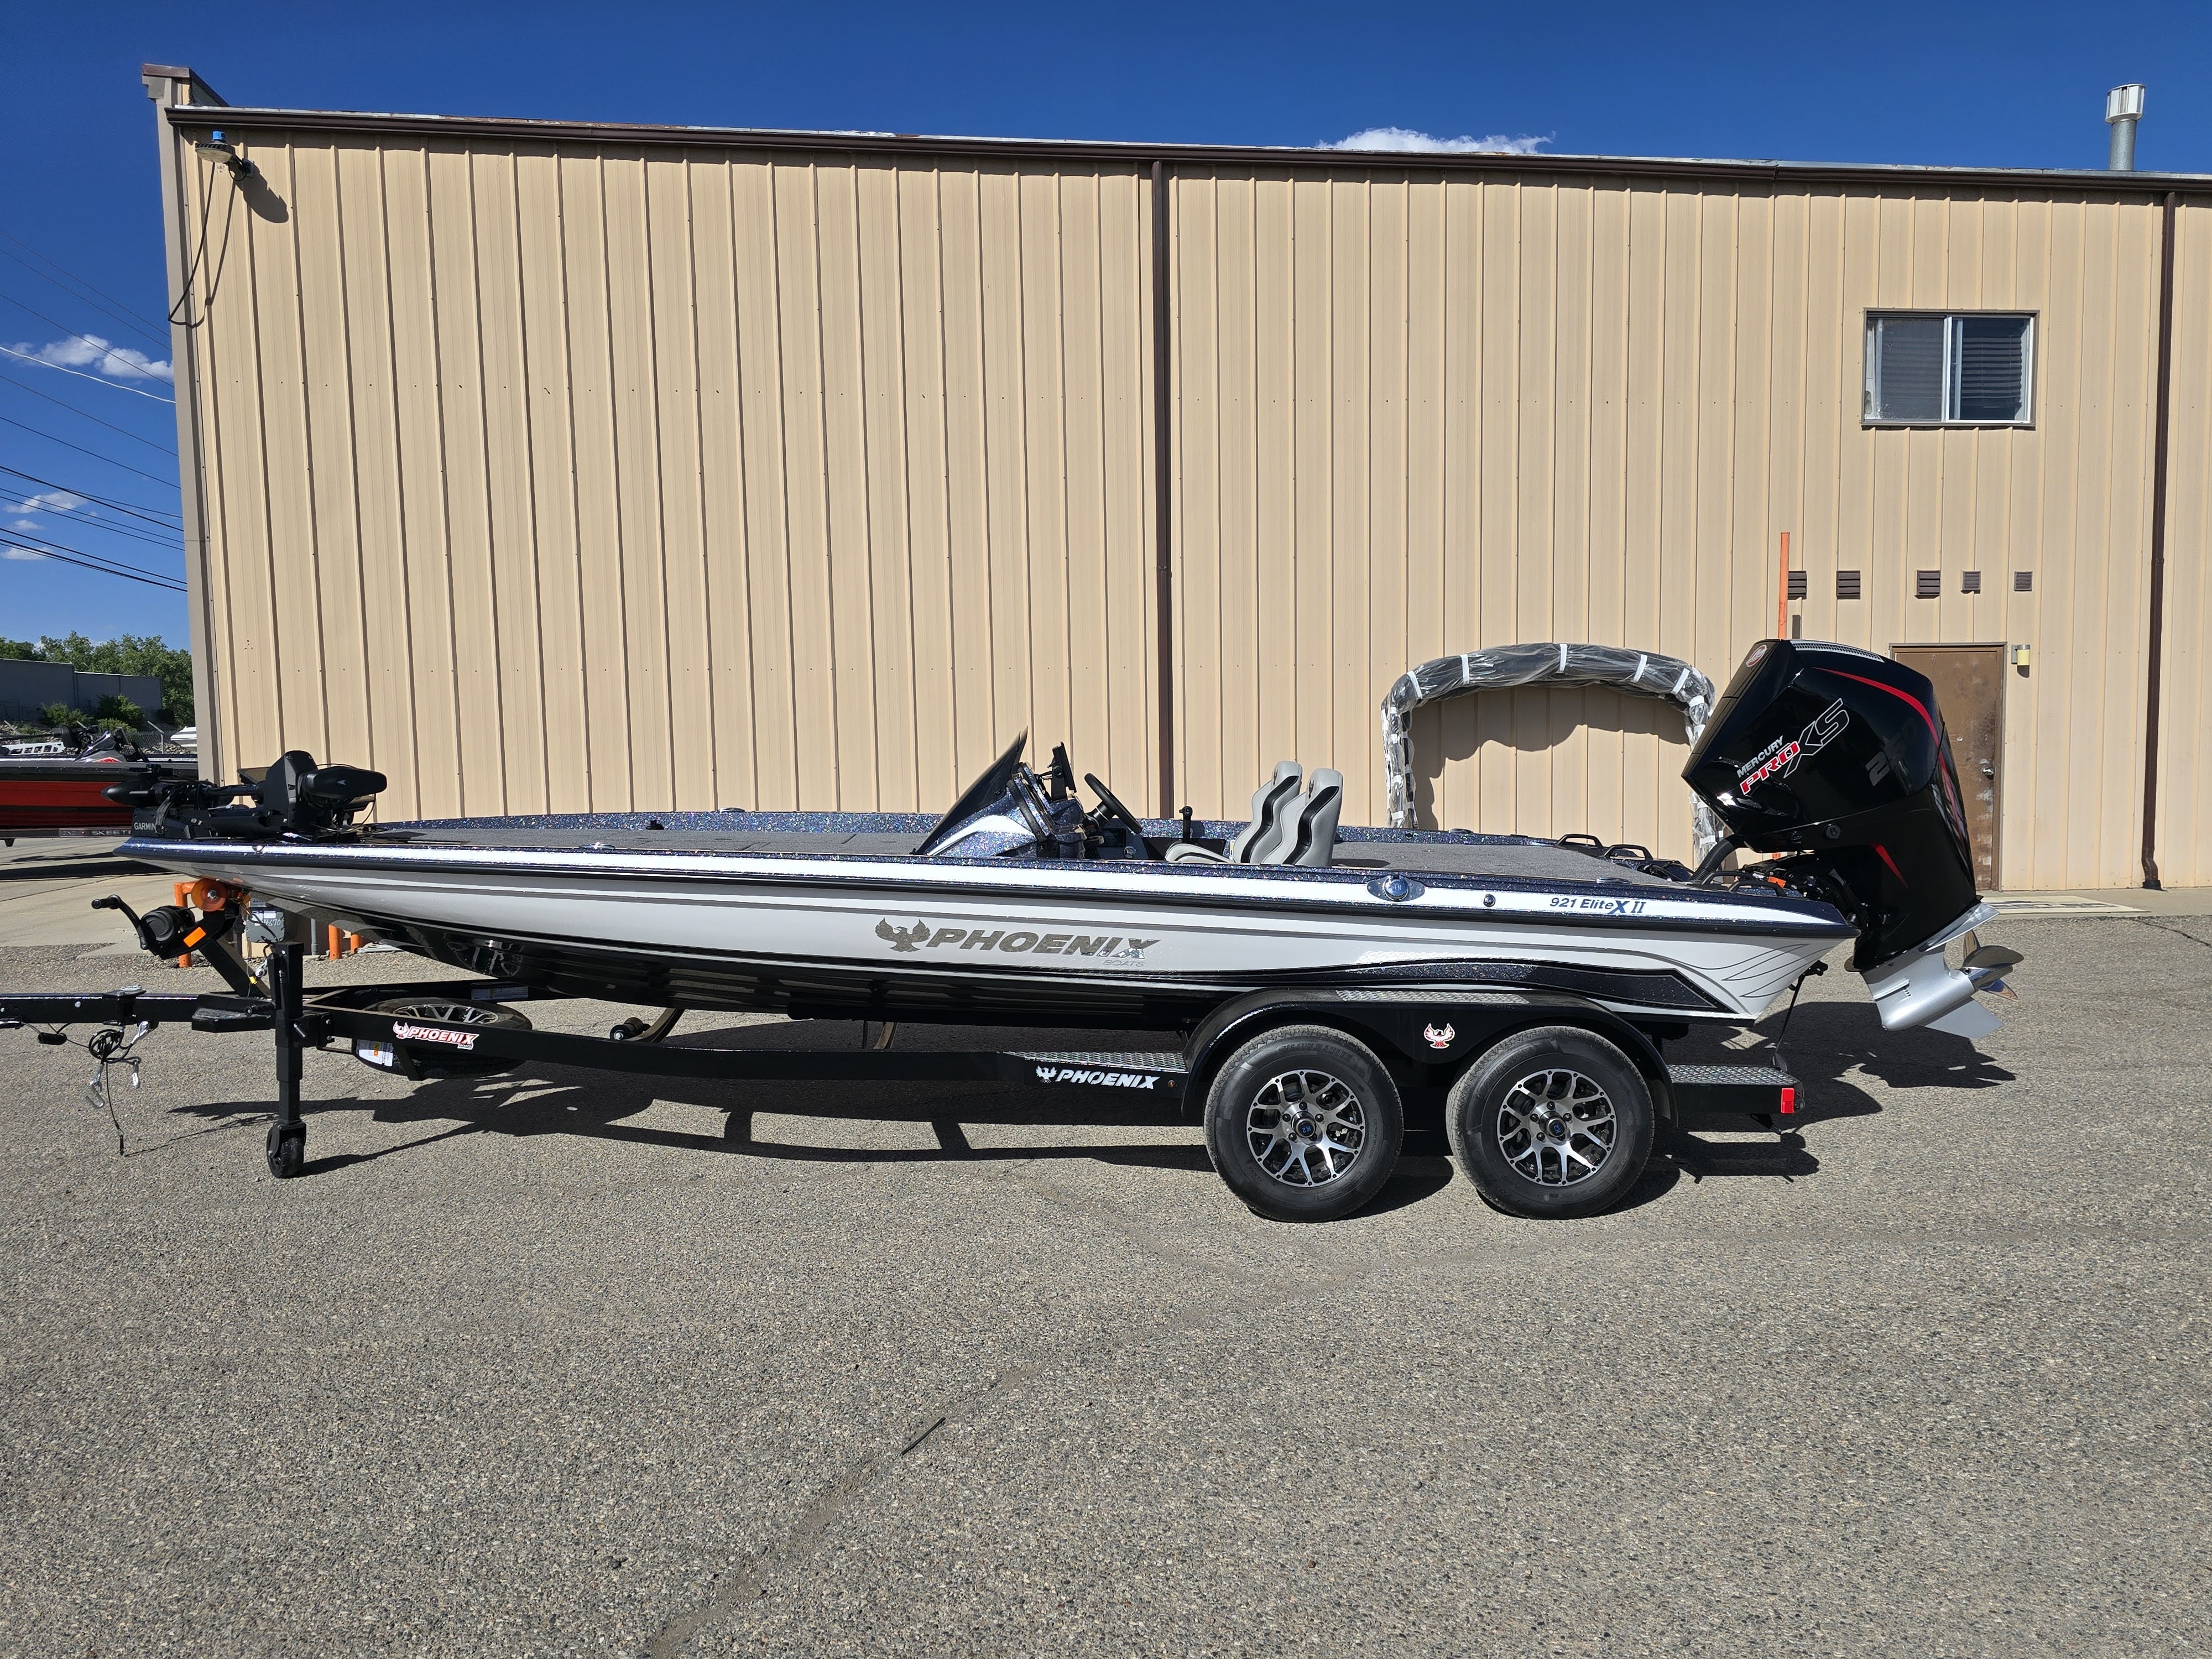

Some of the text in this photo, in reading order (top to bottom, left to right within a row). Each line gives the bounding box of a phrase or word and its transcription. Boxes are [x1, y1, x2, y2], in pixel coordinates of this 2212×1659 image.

[1736, 735, 1783, 778] MERCURY
[134, 822, 156, 831] GARMIN
[1550, 898, 1577, 908] 921
[1630, 901, 1647, 914] II
[926, 928, 1161, 959] PHOENIX
[408, 1027, 475, 1045] PHOENIX
[1055, 1069, 1161, 1089] PHOENIX
[1553, 1124, 1562, 1134] K2
